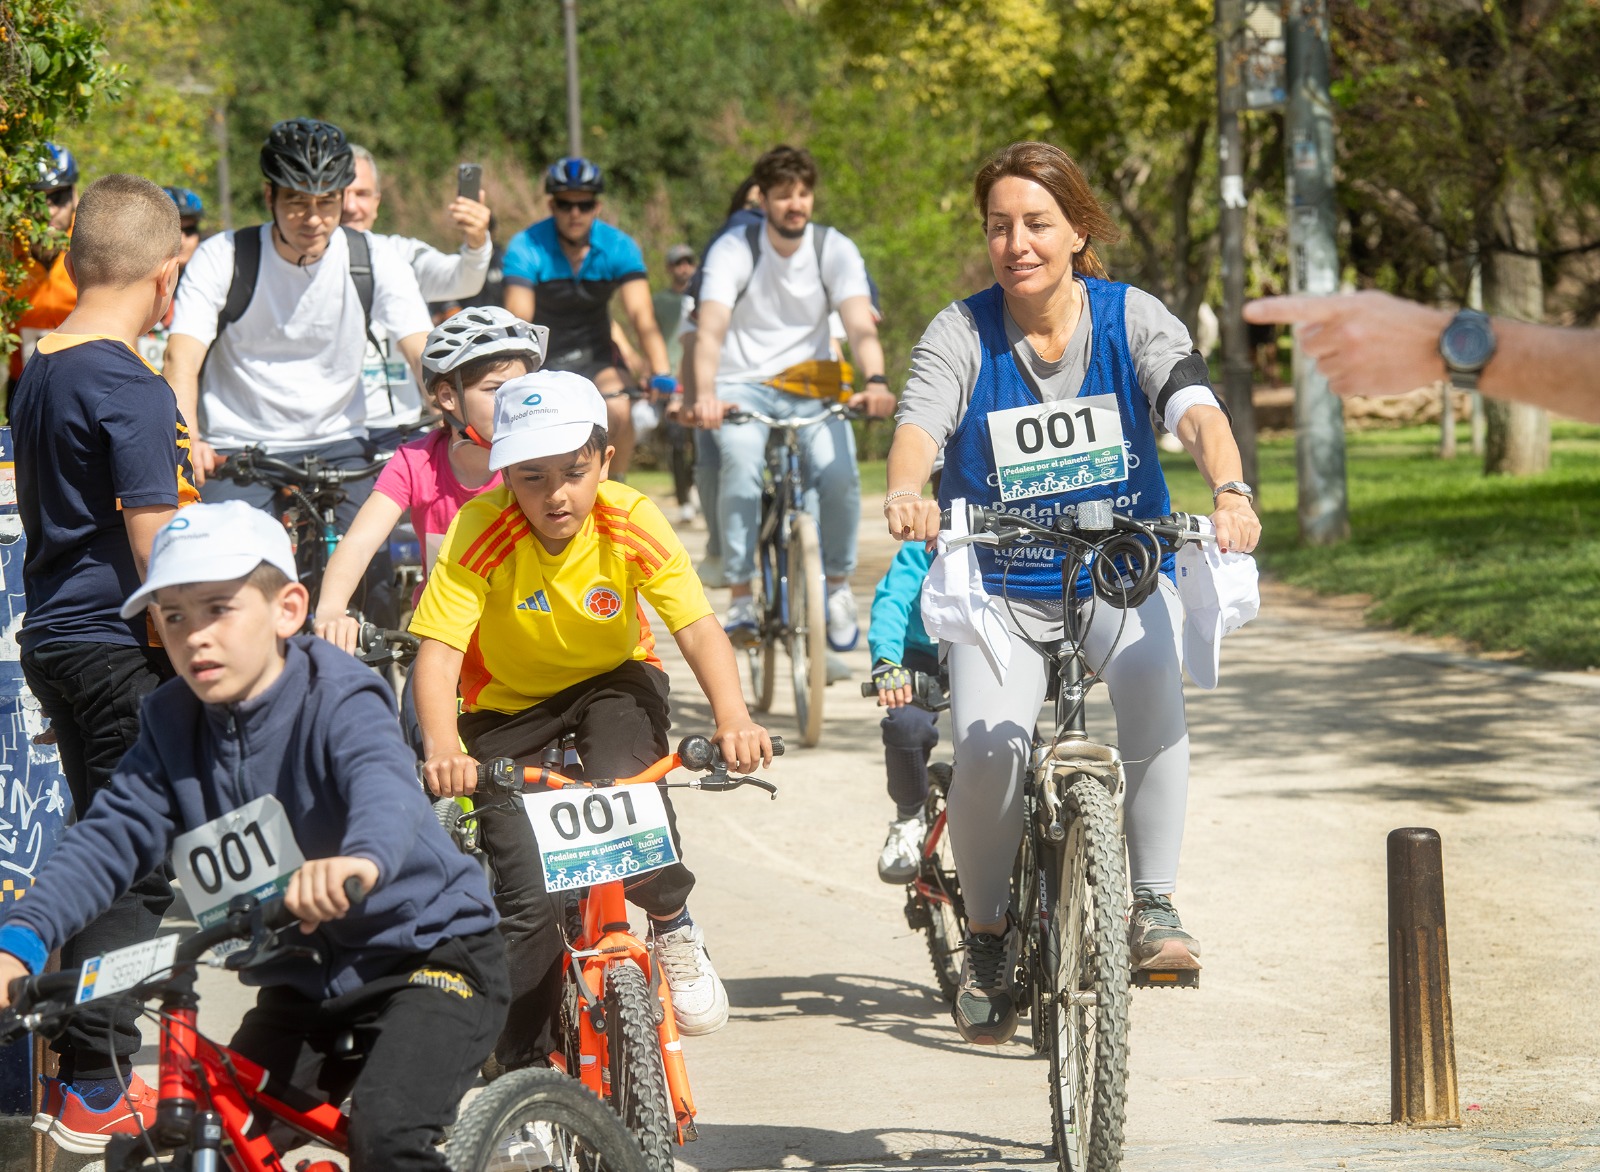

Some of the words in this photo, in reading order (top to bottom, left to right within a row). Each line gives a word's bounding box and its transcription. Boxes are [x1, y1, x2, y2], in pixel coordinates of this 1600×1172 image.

[529, 407, 559, 416] omnium
[1015, 407, 1096, 454] 001
[1003, 464, 1036, 478] ¡Pedalea
[1036, 463, 1050, 472] por
[1051, 460, 1059, 468] el
[1059, 455, 1091, 469] planeta!
[994, 557, 1003, 566] by
[550, 791, 637, 840] 001
[547, 852, 577, 865] ¡Pedalea
[578, 849, 591, 859] por
[592, 847, 599, 856] el
[599, 839, 634, 855] planeta!
[638, 837, 664, 849] tuawa
[189, 821, 276, 894] 001
[1040, 869, 1048, 912] ZOOM
